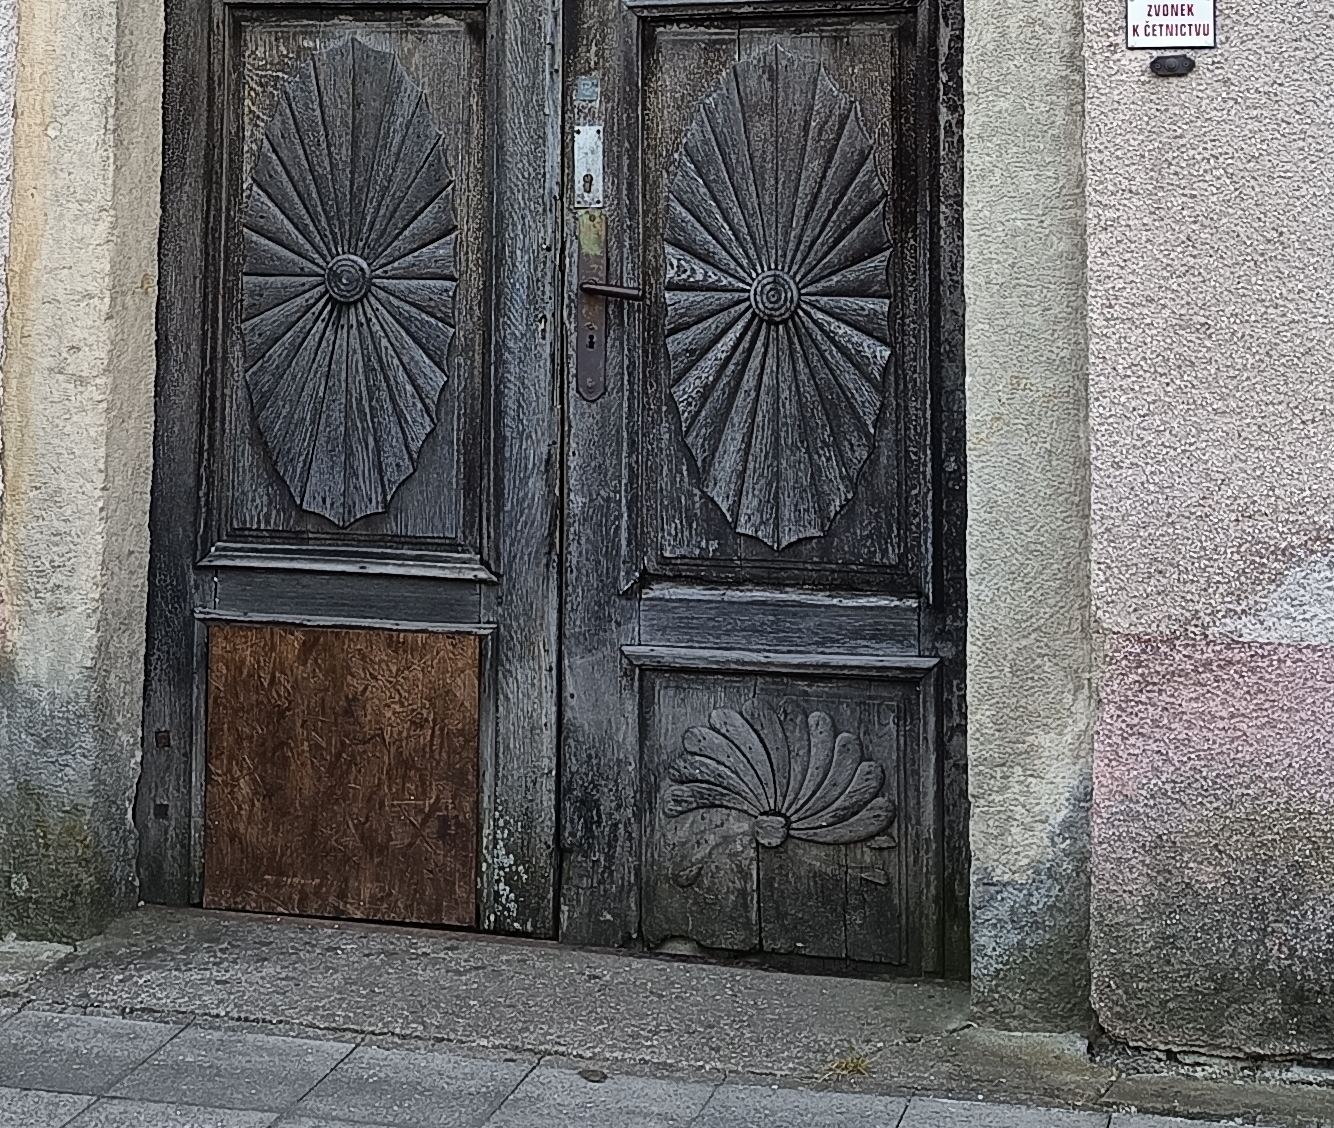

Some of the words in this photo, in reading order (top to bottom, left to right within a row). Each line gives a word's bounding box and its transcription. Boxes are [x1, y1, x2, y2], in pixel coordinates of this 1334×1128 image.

[1147, 4, 1194, 17] ZVONEK
[1132, 24, 1140, 37] K
[1144, 20, 1210, 37] ČETNICTVU
